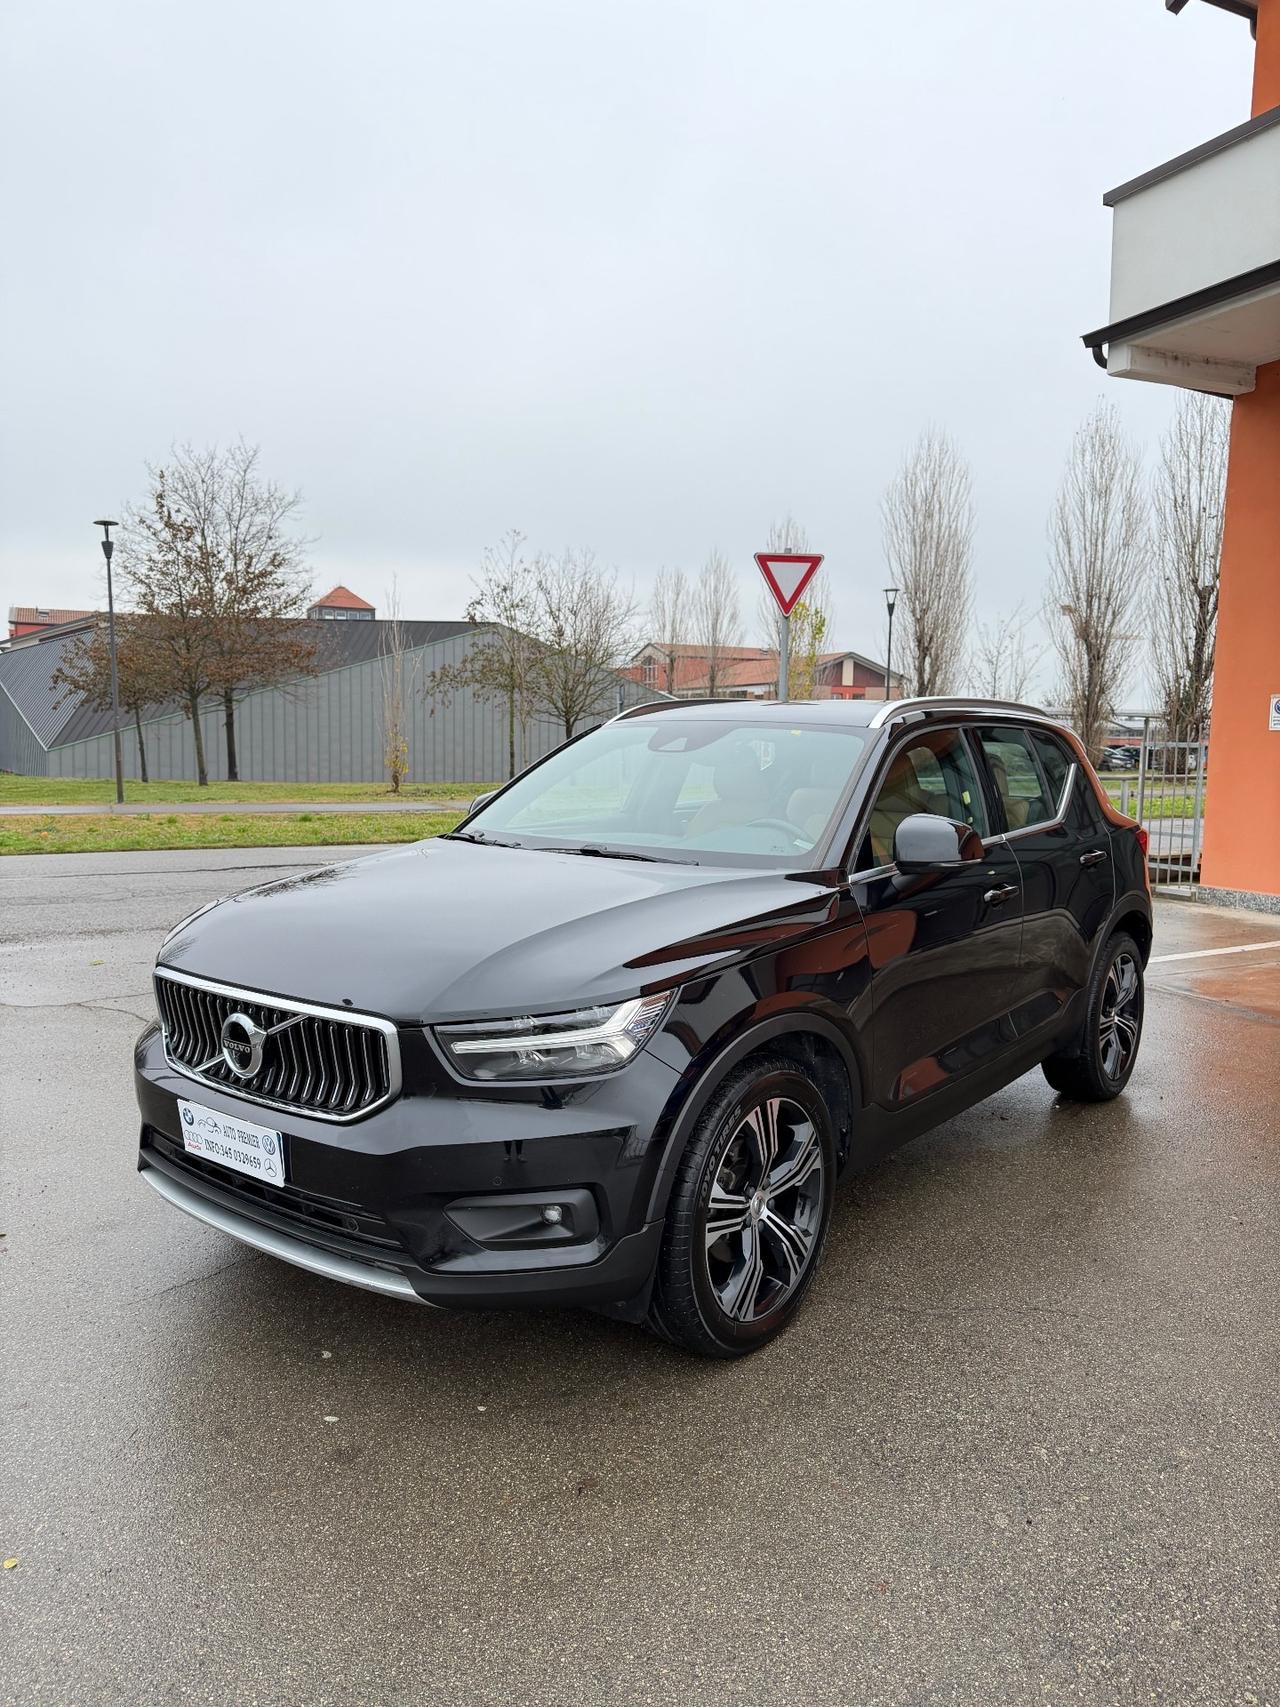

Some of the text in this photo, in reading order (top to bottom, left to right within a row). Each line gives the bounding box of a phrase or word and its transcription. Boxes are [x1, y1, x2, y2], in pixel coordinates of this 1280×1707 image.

[223, 1039, 251, 1054] VOLVO
[223, 1124, 261, 1149] AUTO PREMIER
[715, 1104, 742, 1153] TIRES
[233, 1149, 262, 1170] 0329659
